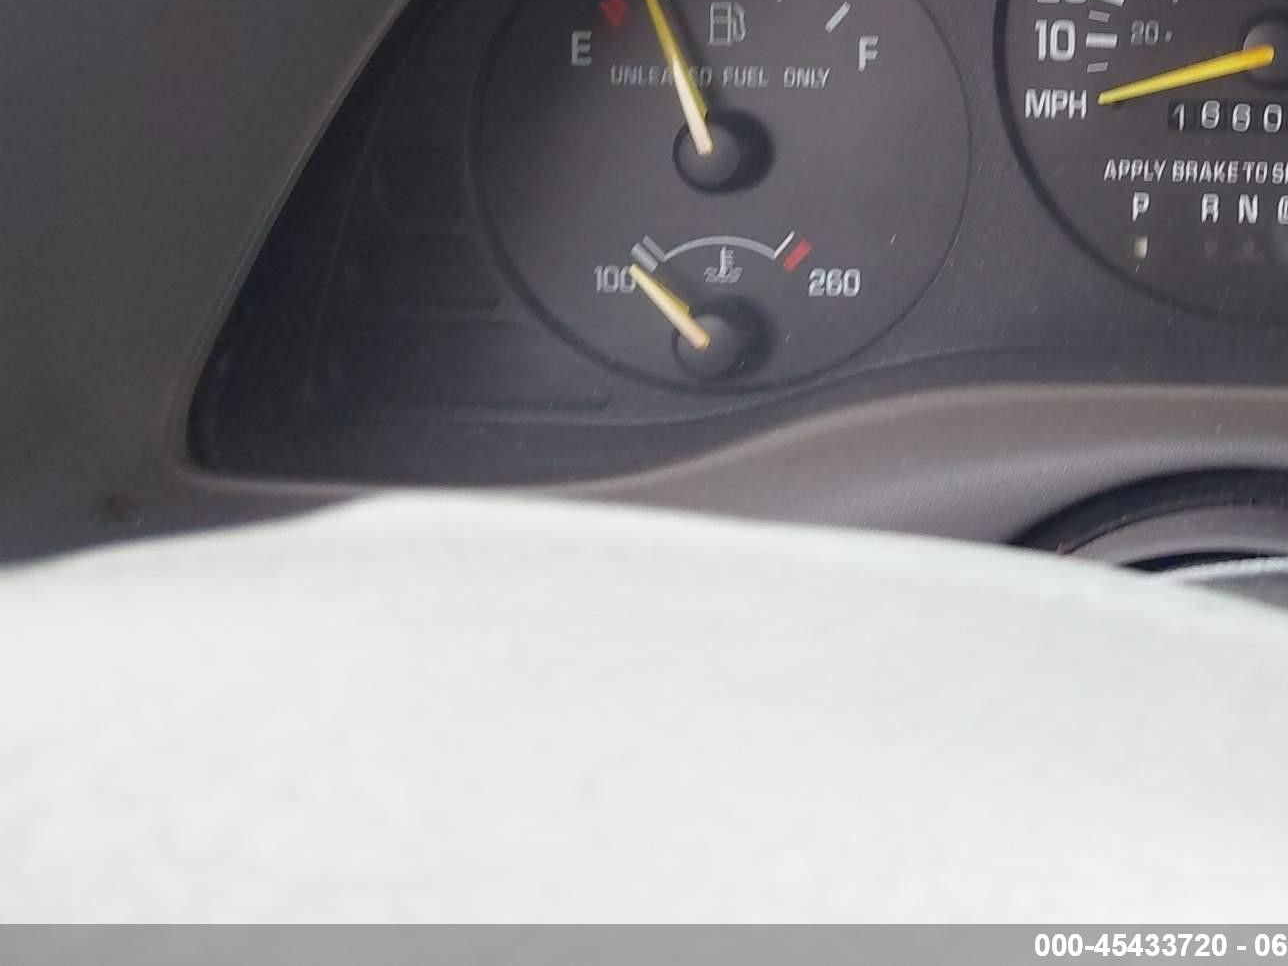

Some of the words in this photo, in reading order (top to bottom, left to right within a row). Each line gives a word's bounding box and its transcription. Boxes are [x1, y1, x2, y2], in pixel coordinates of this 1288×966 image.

[1034, 18, 1077, 63] 10
[1130, 20, 1160, 46] 20
[571, 30, 594, 68] E
[858, 35, 880, 73] F
[611, 64, 713, 87] UNLEAED
[723, 65, 769, 88] FUEL
[783, 66, 831, 89] ONLY
[1024, 88, 1088, 120] MPH
[1104, 159, 1167, 183] APPLY
[1172, 160, 1239, 184] BRAKE
[1242, 162, 1268, 185] TO
[1132, 192, 1150, 222] P
[1202, 193, 1219, 224] R
[1238, 194, 1258, 225] N
[594, 265, 637, 293] 100
[808, 267, 862, 297] 260
